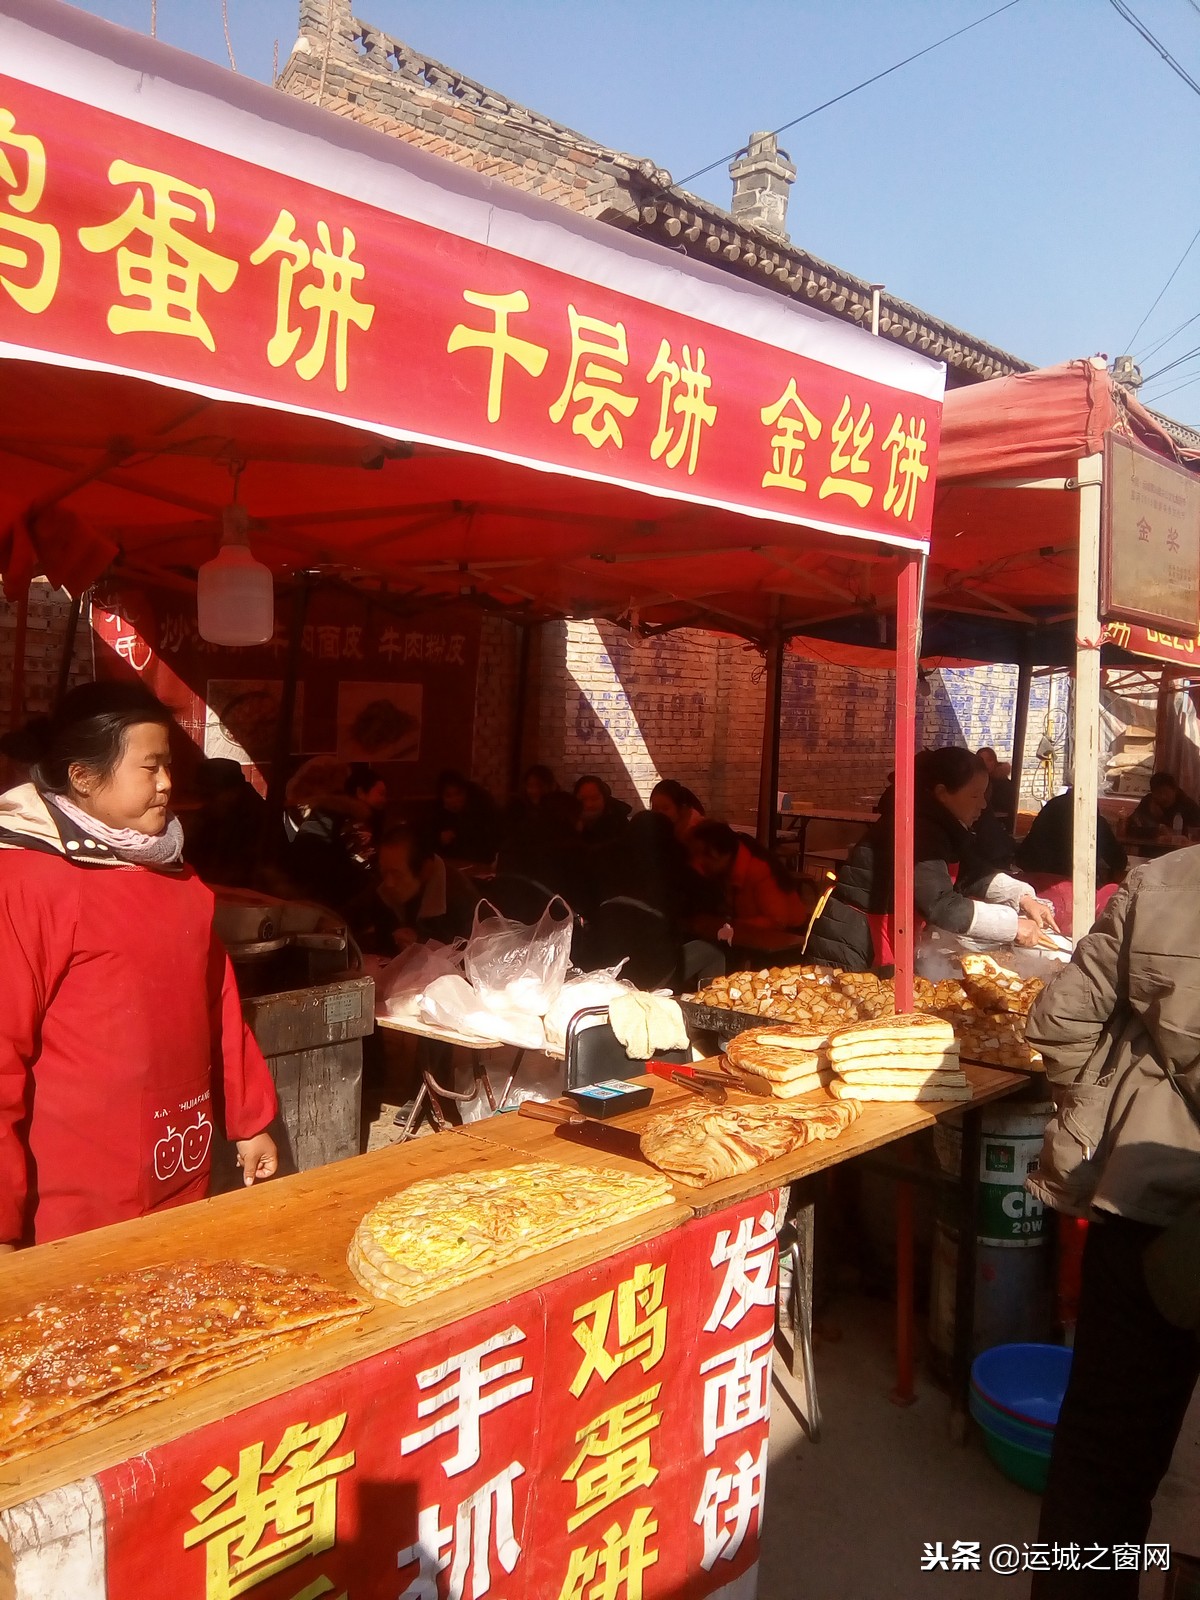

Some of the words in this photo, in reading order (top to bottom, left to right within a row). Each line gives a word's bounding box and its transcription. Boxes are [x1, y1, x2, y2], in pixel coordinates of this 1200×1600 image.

[446, 289, 718, 476] 千层饼
[760, 377, 930, 522] 金丝饼
[378, 626, 466, 666] 牛肉粉皮
[183, 1411, 357, 1600] 酱
[557, 1262, 668, 1600] 鸡蛋饼
[693, 1210, 779, 1573] 发面饼
